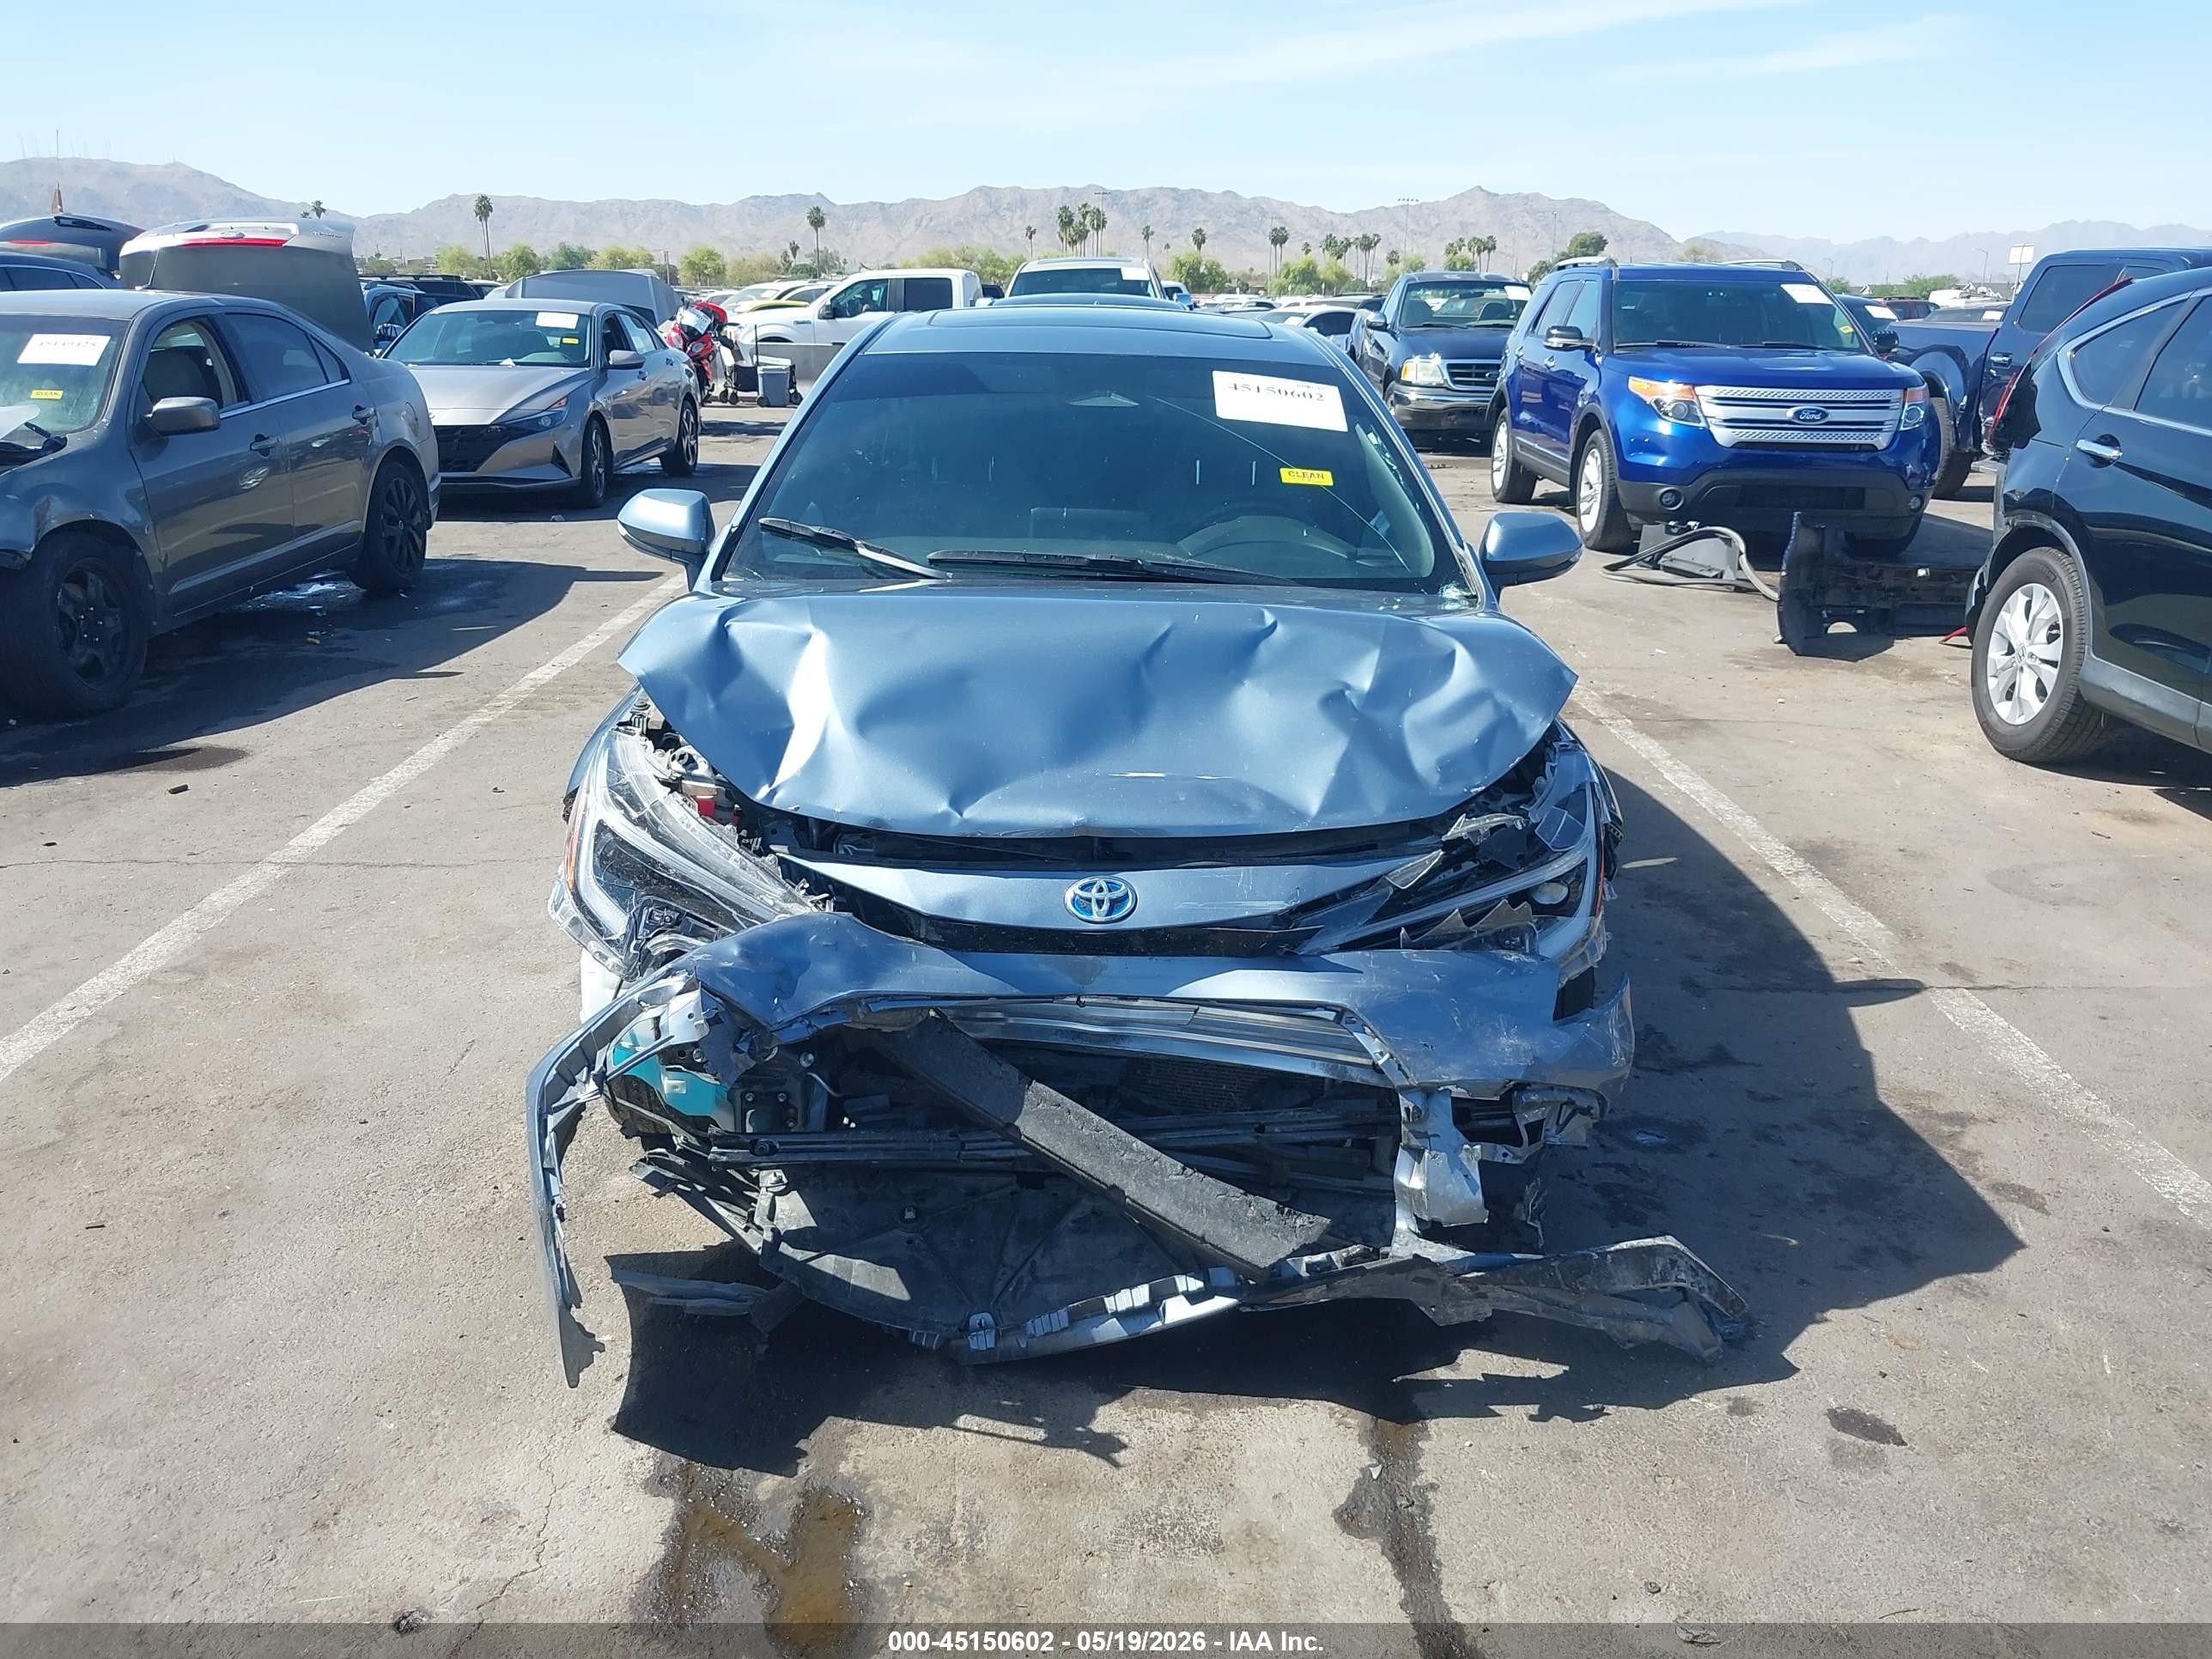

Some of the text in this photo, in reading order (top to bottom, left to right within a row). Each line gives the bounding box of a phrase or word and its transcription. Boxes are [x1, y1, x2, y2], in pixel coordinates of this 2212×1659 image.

[1228, 382, 1327, 402] 45150602
[1799, 410, 1822, 420] Ford
[1287, 470, 1326, 480] CLEAN
